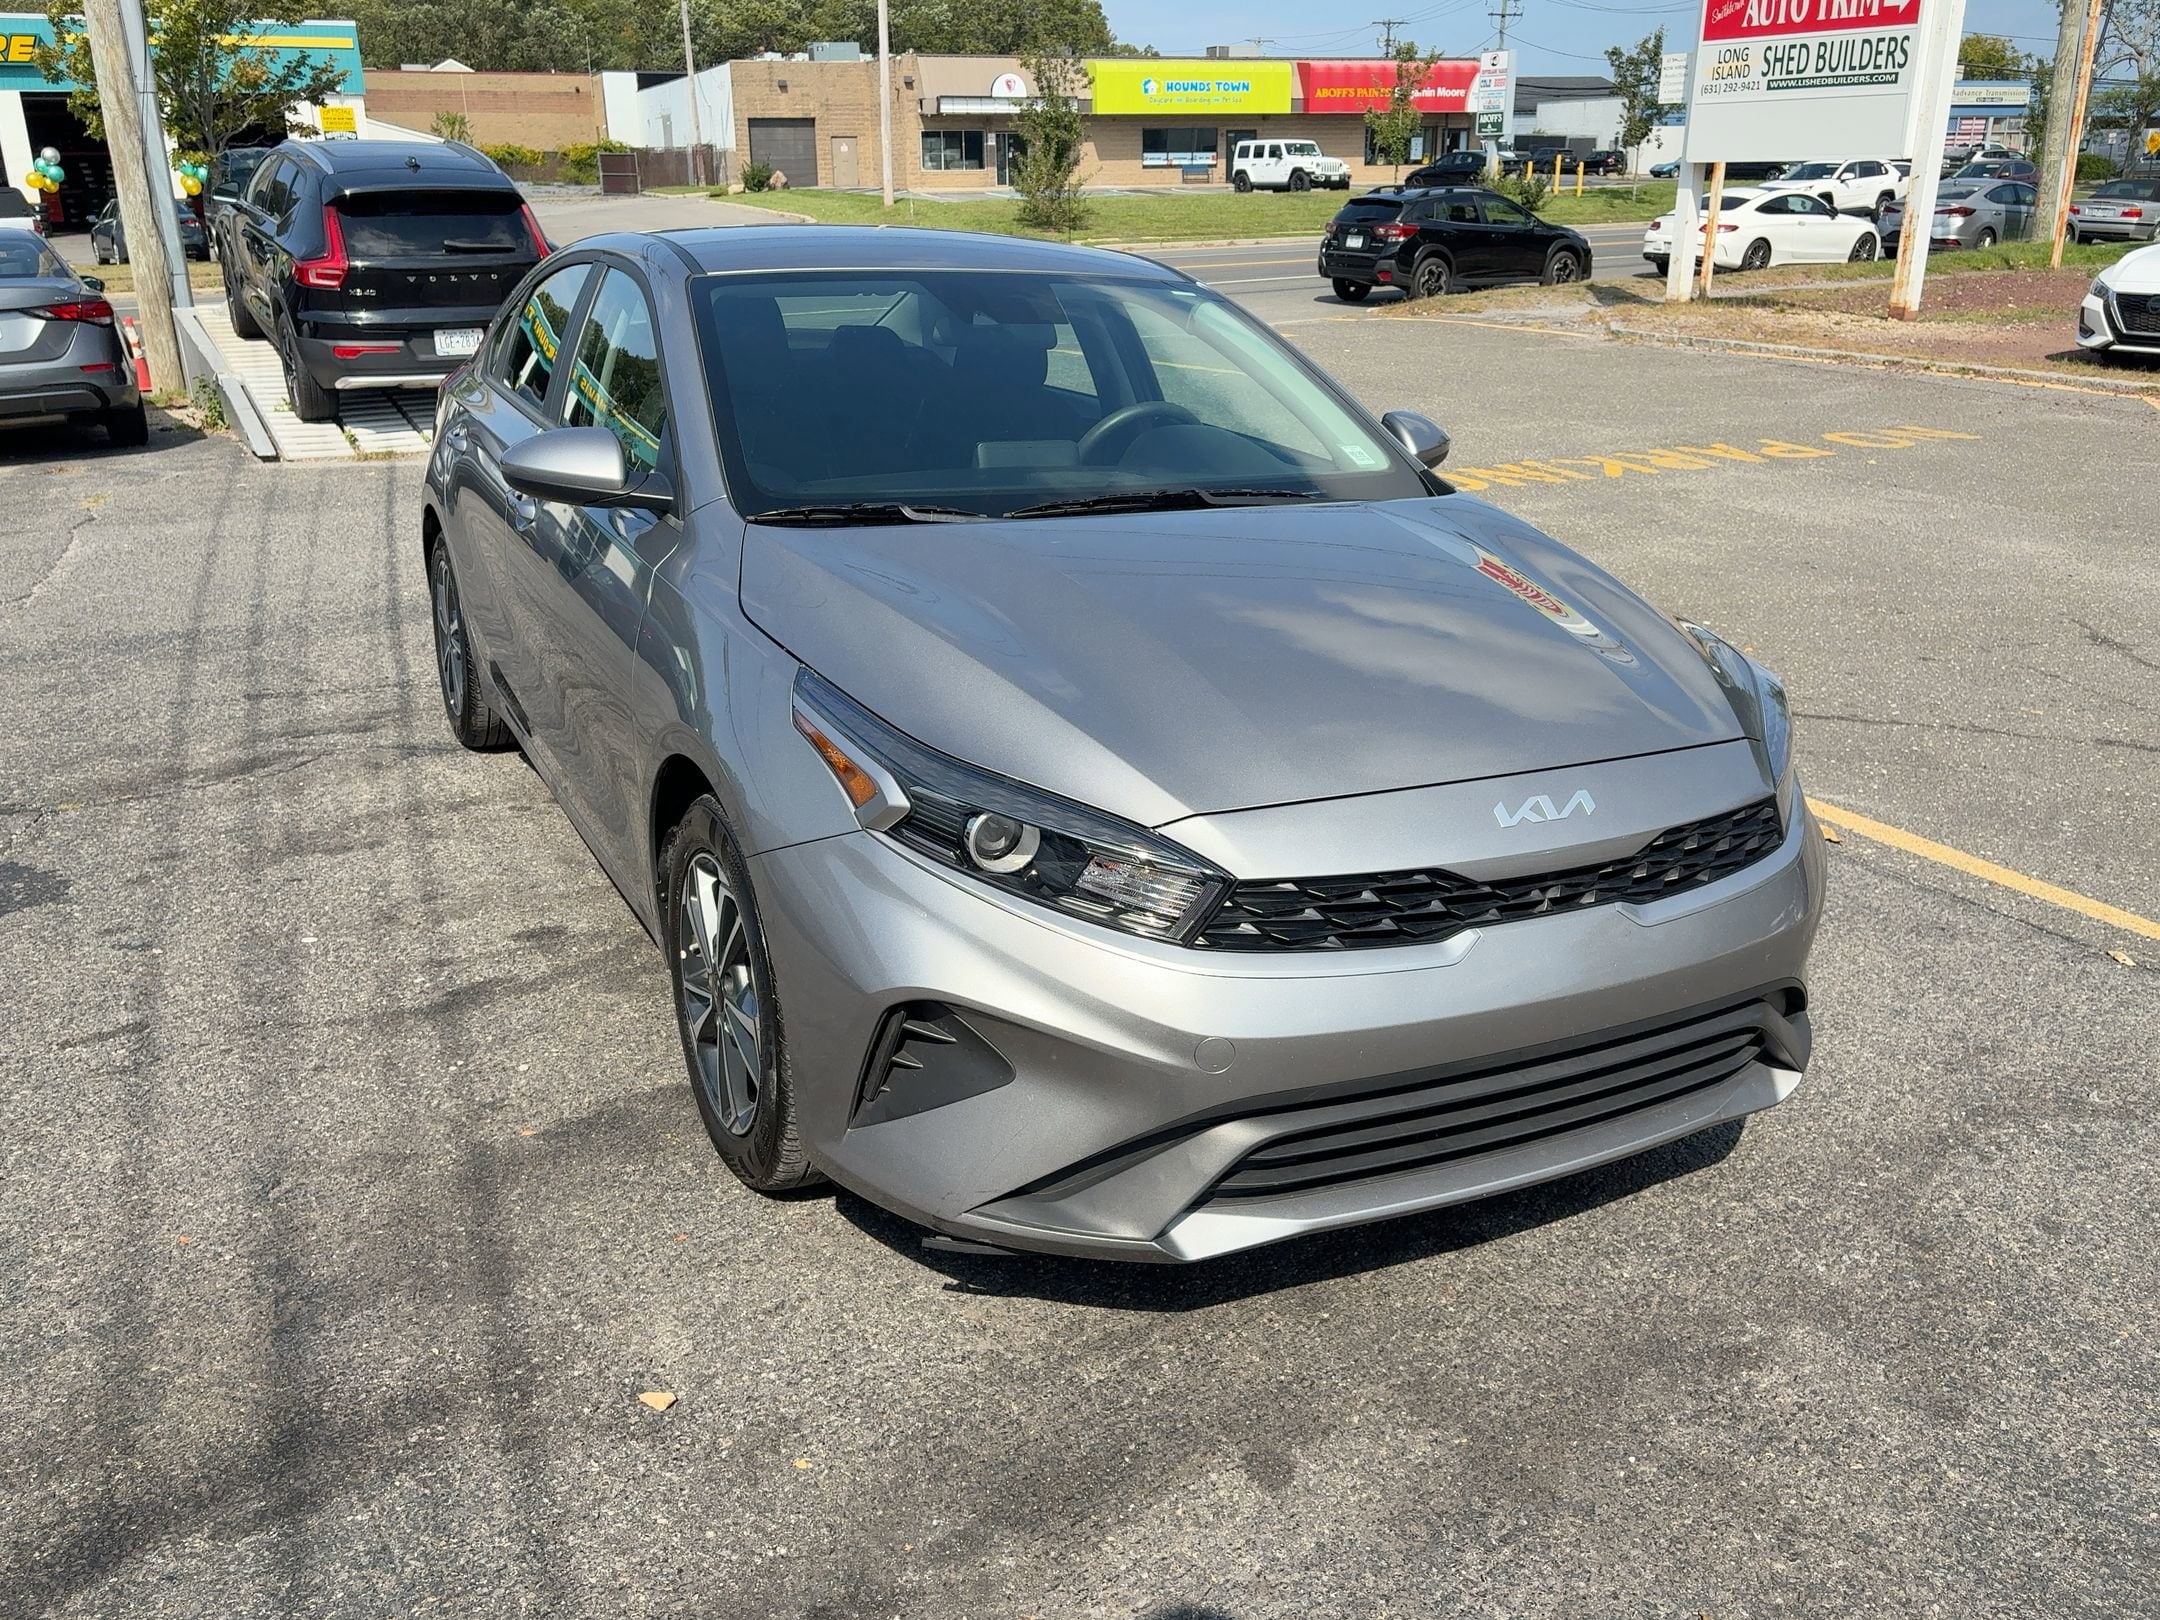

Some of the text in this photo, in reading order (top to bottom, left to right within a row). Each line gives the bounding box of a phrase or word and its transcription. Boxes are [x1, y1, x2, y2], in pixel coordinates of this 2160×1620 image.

[1717, 47, 1750, 64] LONG
[1761, 34, 1910, 77] SHED BUILDERS
[1711, 63, 1750, 81] ISLAND
[1166, 81, 1250, 92] HOUNDS TOWN
[1700, 79, 1760, 96] (631) 292-9421
[1769, 73, 1897, 89] WWW.LISHEDBUILDERS.COM
[1437, 86, 1465, 97] Moore
[406, 273, 498, 283] VOLVO
[1493, 789, 1596, 828] KIA
